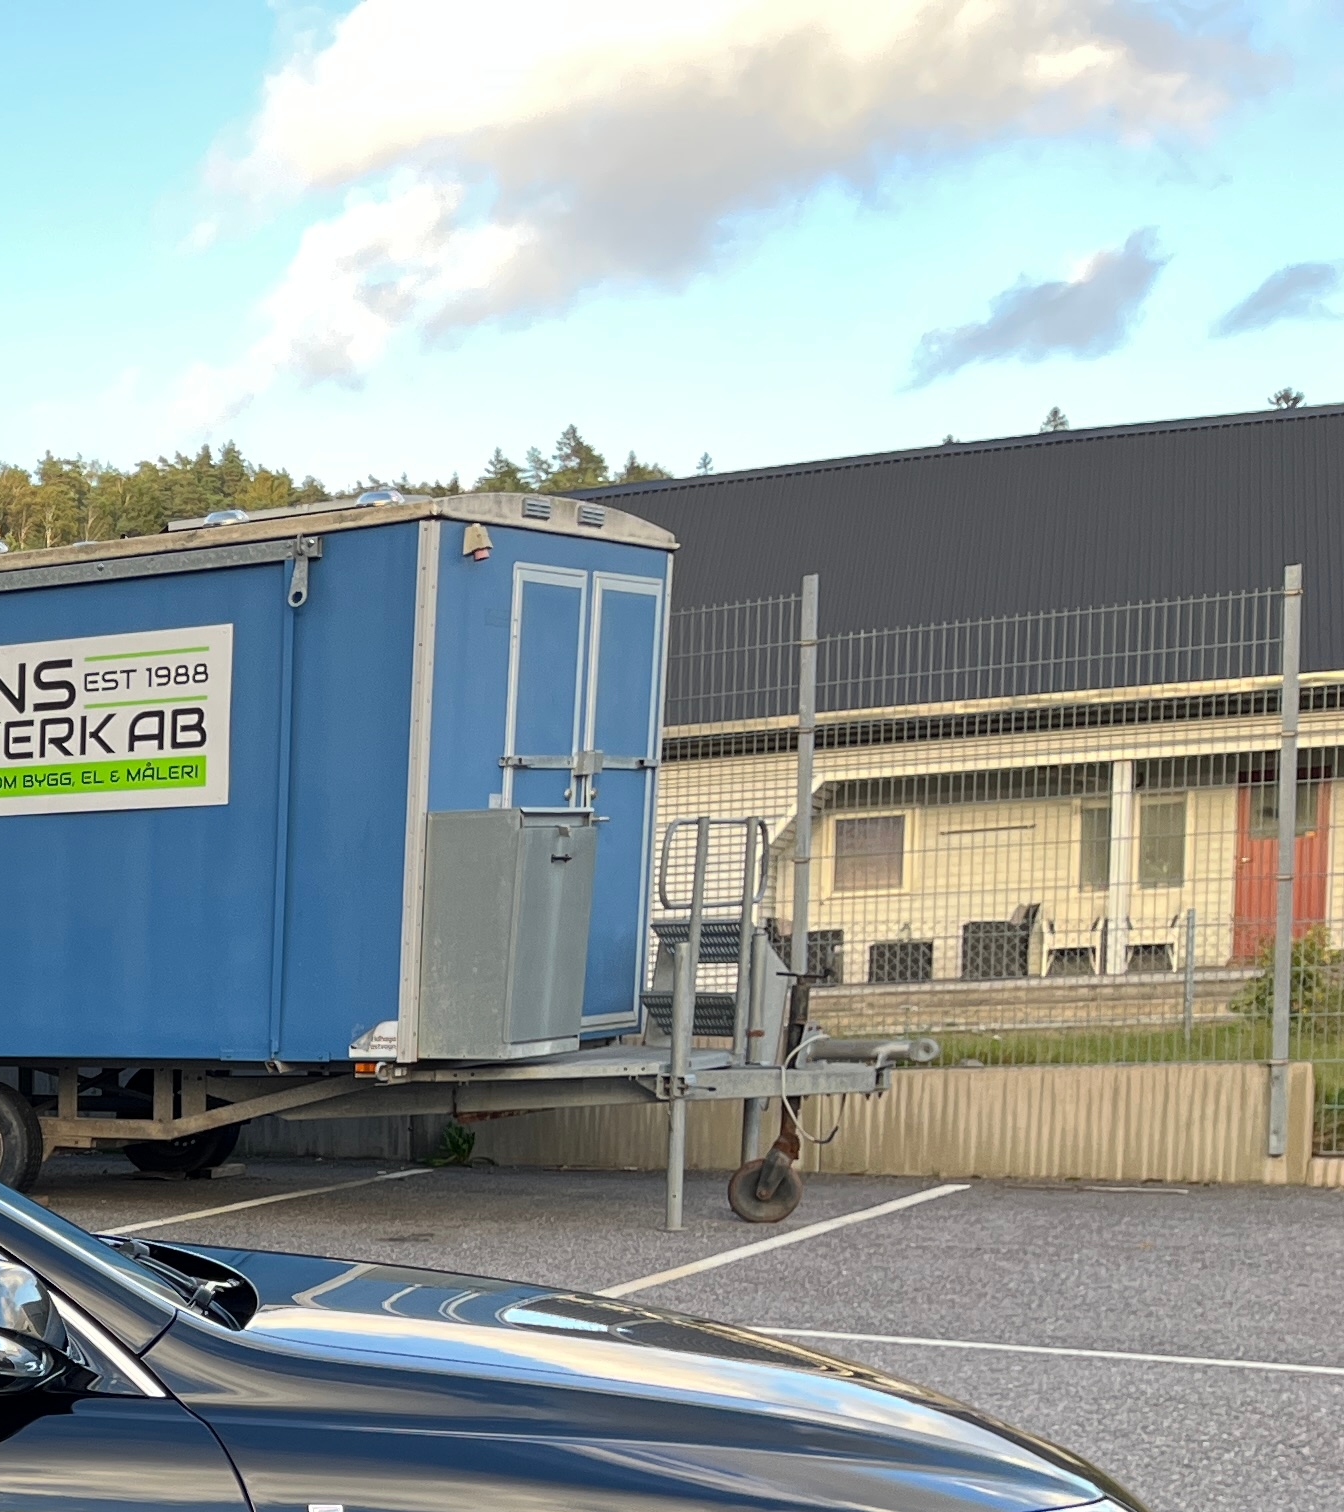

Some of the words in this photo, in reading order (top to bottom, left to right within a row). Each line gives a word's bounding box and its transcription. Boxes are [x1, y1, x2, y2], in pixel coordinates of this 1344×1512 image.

[84, 669, 138, 693] EST
[145, 663, 209, 688] 1988
[127, 707, 207, 753] AB
[22, 771, 76, 789] BYGG,
[81, 770, 104, 785] EL
[109, 770, 120, 783] &
[126, 761, 199, 782] MÅLERI
